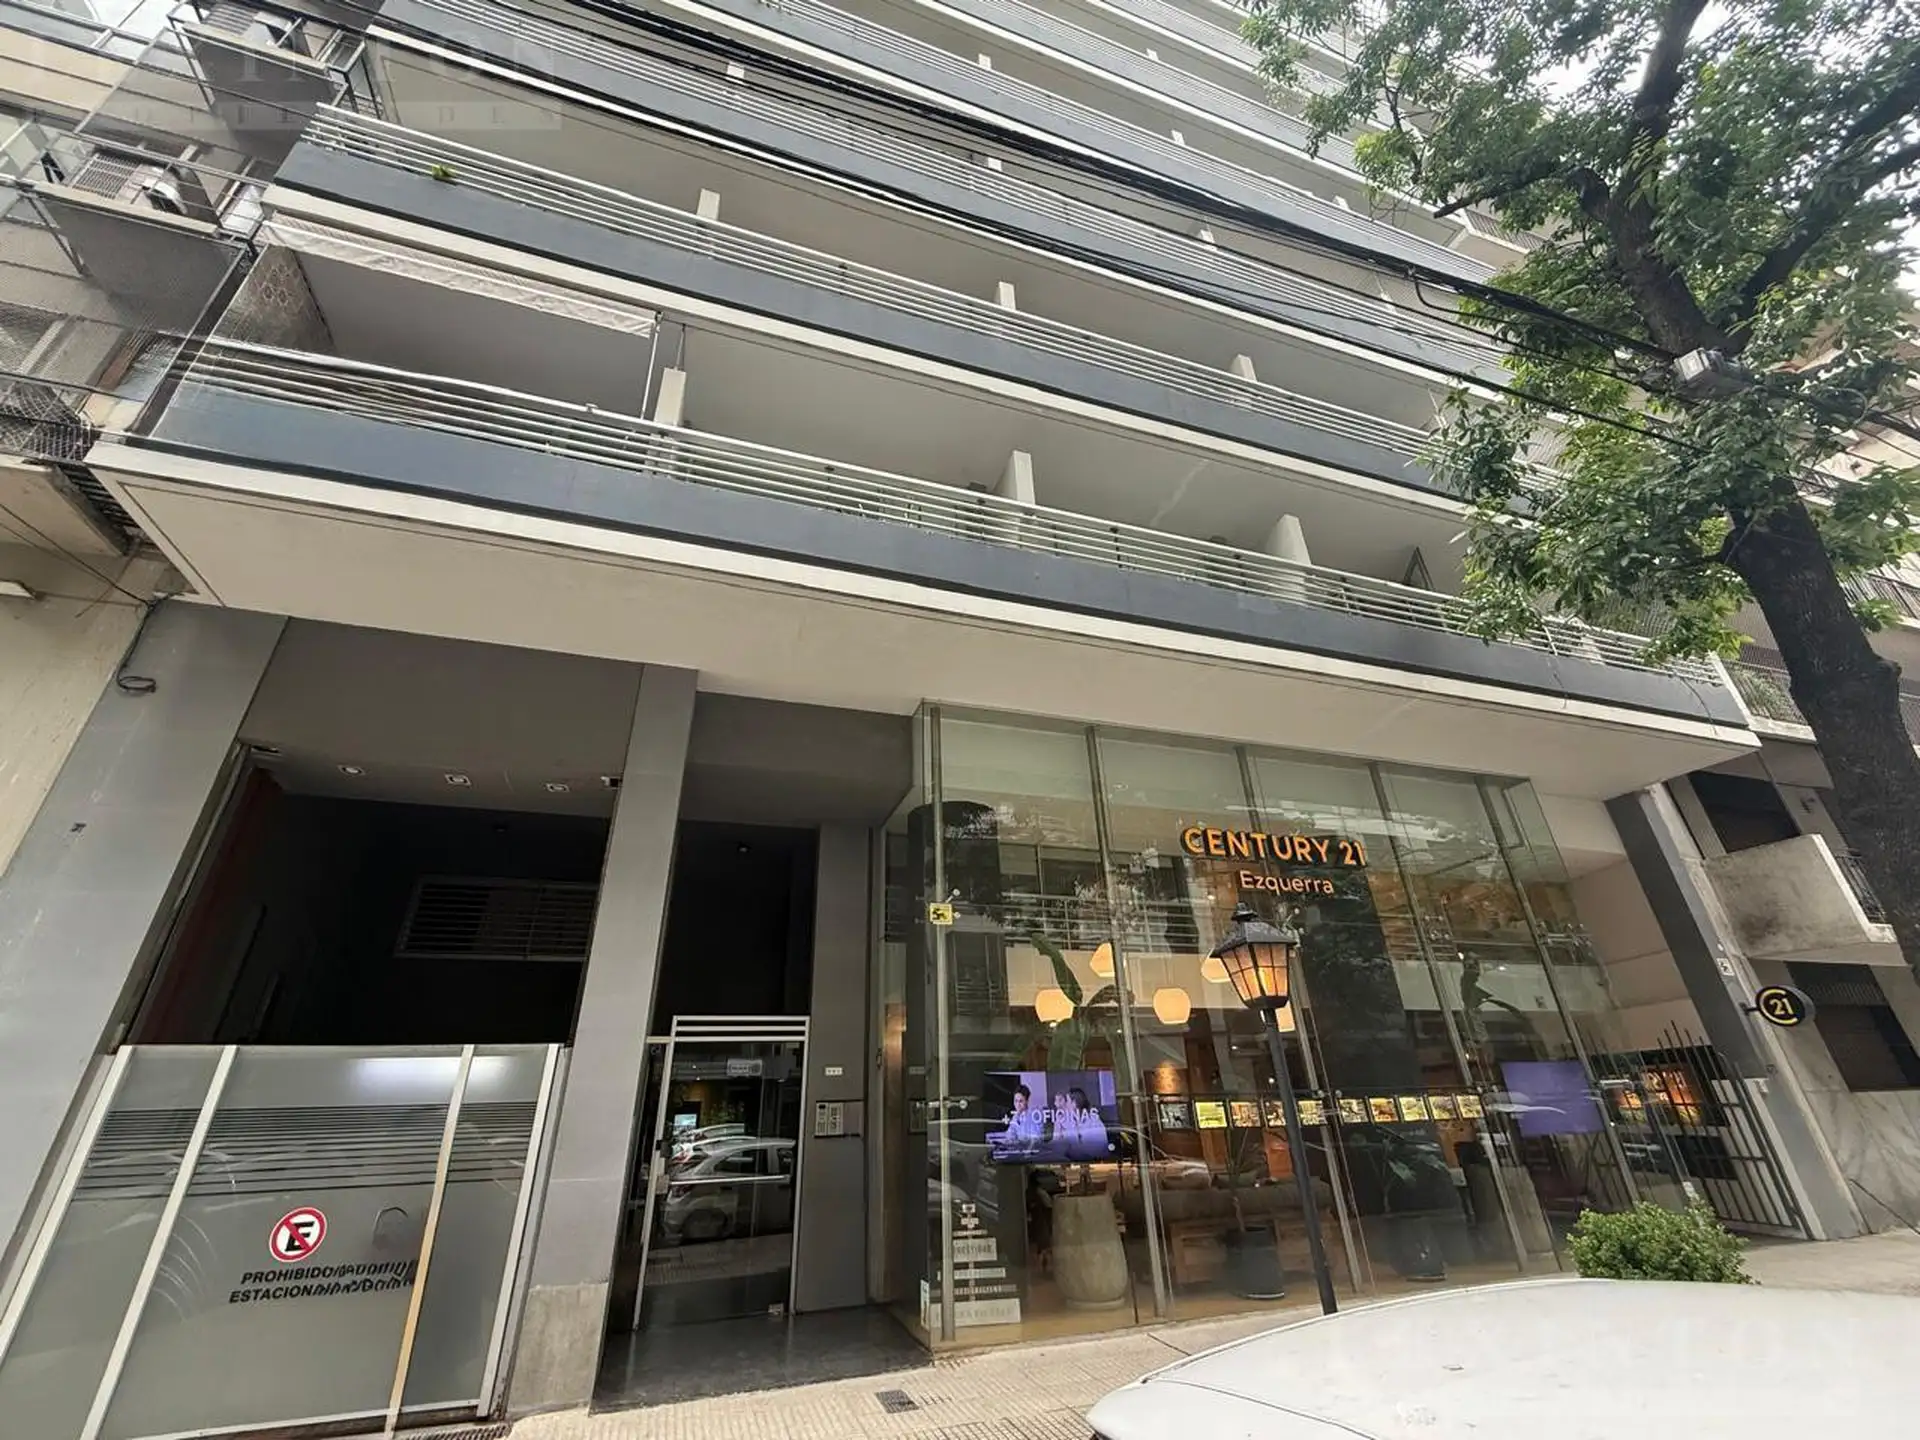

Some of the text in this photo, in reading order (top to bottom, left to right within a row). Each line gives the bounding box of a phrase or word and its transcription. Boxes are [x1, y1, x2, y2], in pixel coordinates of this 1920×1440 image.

[1182, 827, 1367, 867] CENTURY 21
[1239, 870, 1335, 896] Ezquerra
[1031, 1107, 1100, 1124] OFICINAS
